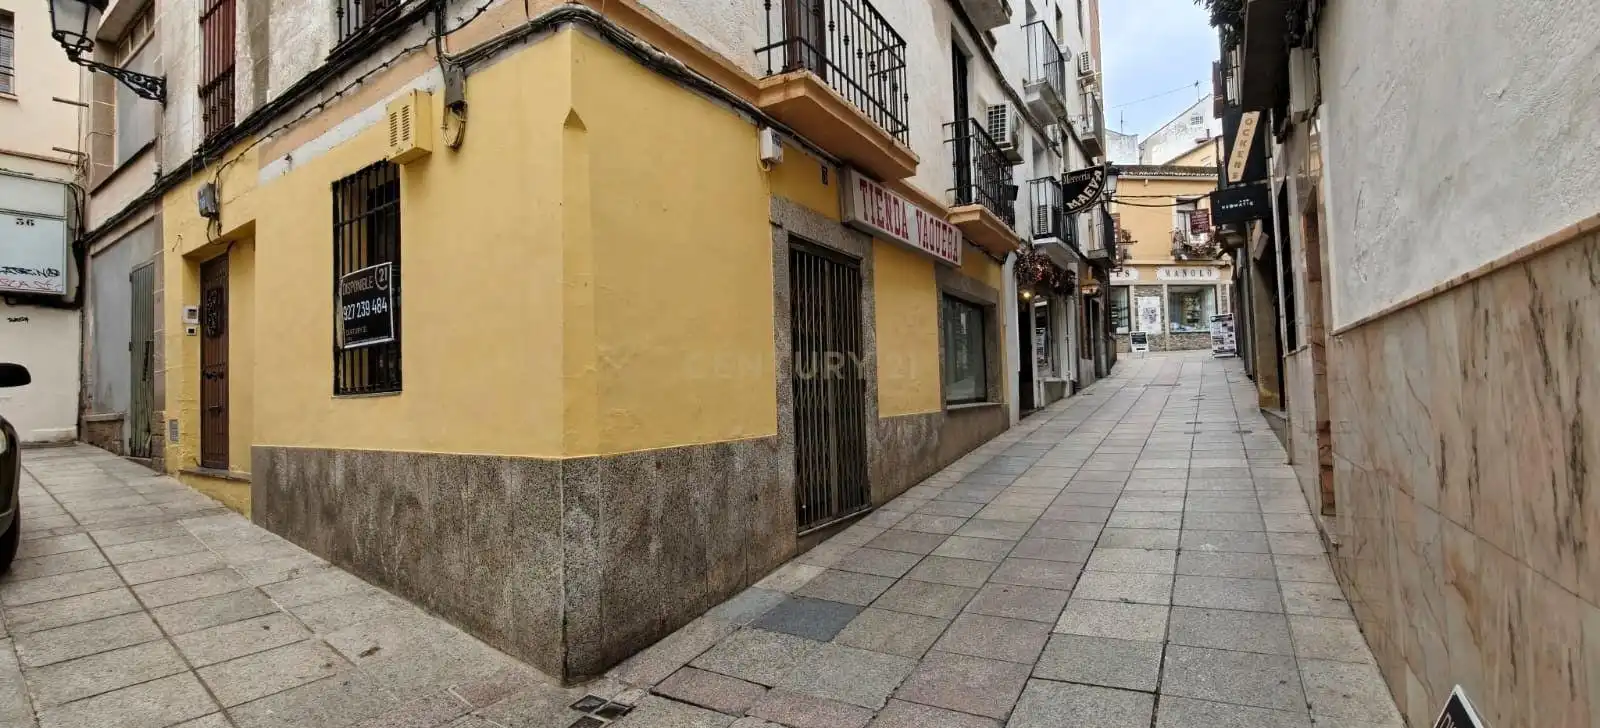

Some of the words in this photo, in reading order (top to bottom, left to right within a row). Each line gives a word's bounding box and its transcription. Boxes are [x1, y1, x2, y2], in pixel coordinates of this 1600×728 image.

[1066, 170, 1102, 209] MAEVA
[860, 179, 909, 240] TIENDA
[916, 209, 958, 263] VAQUERA
[379, 267, 388, 281] 21
[342, 276, 374, 296] DISPONIBLE
[343, 304, 356, 320] 927
[357, 300, 371, 318] 239
[372, 297, 388, 314] 484
